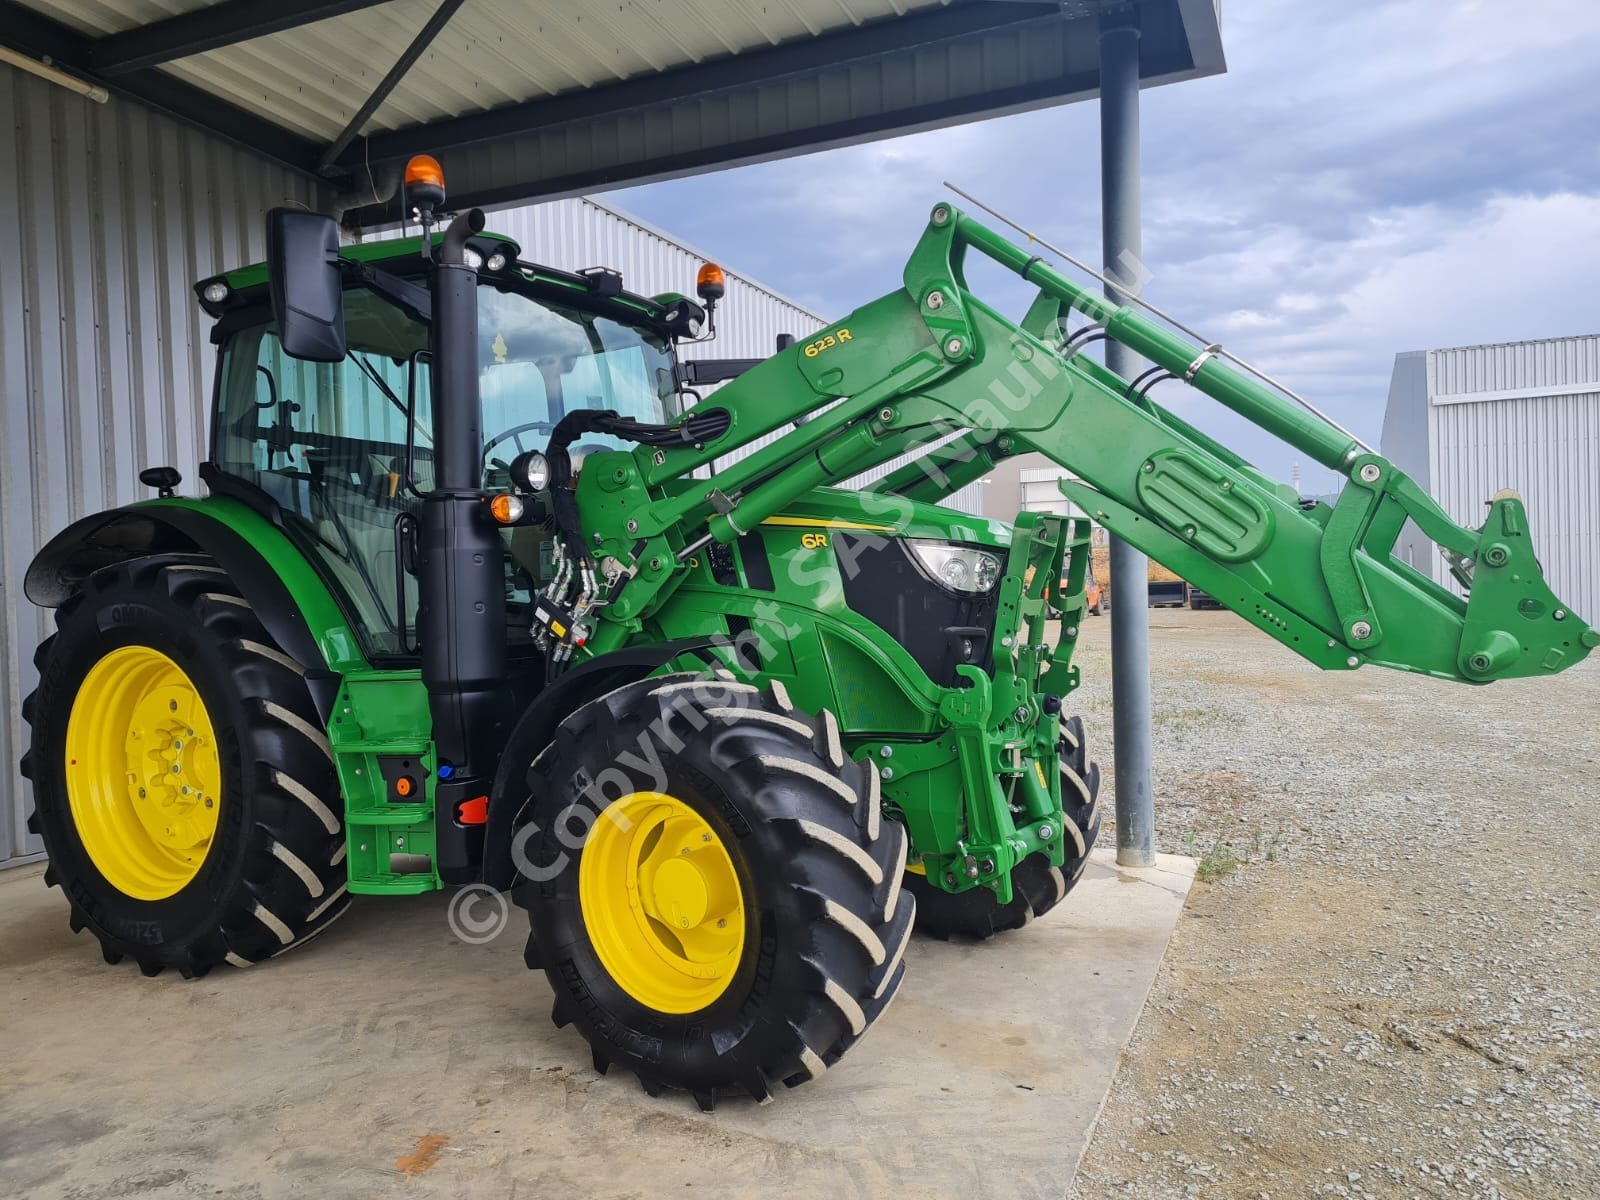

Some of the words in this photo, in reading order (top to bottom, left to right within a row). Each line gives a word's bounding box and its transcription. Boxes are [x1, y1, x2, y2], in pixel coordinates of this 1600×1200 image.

[804, 335, 836, 357] 623
[836, 328, 853, 343] R
[801, 533, 828, 550] 6R
